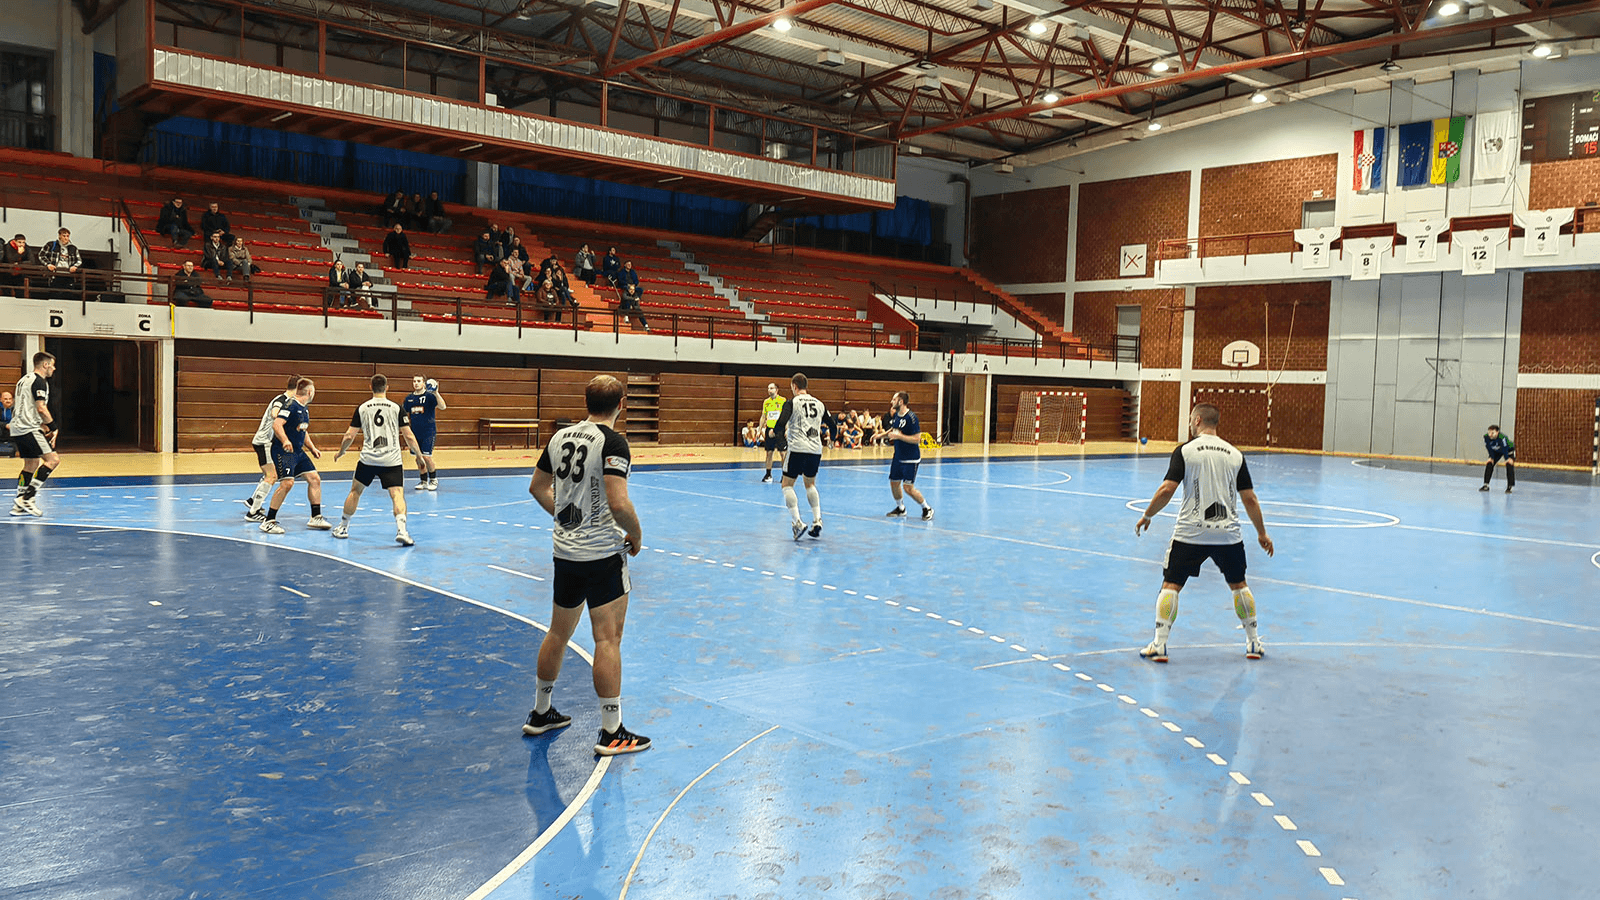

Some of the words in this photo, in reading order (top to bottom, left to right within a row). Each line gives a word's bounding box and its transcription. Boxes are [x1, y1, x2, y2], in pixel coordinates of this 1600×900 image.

[1584, 142, 1598, 154] 15
[312, 223, 322, 232] VII
[1537, 231, 1546, 241] 4
[322, 237, 331, 246] VI
[1418, 240, 1426, 249] 7
[1313, 247, 1320, 256] 2
[1471, 250, 1487, 260] 12
[1363, 257, 1370, 266] 8
[49, 315, 63, 328] D
[138, 319, 151, 332] C
[982, 363, 989, 372] A
[802, 402, 818, 418] 15
[373, 409, 385, 427] 6
[556, 441, 588, 484] 33
[285, 467, 291, 475] 7
